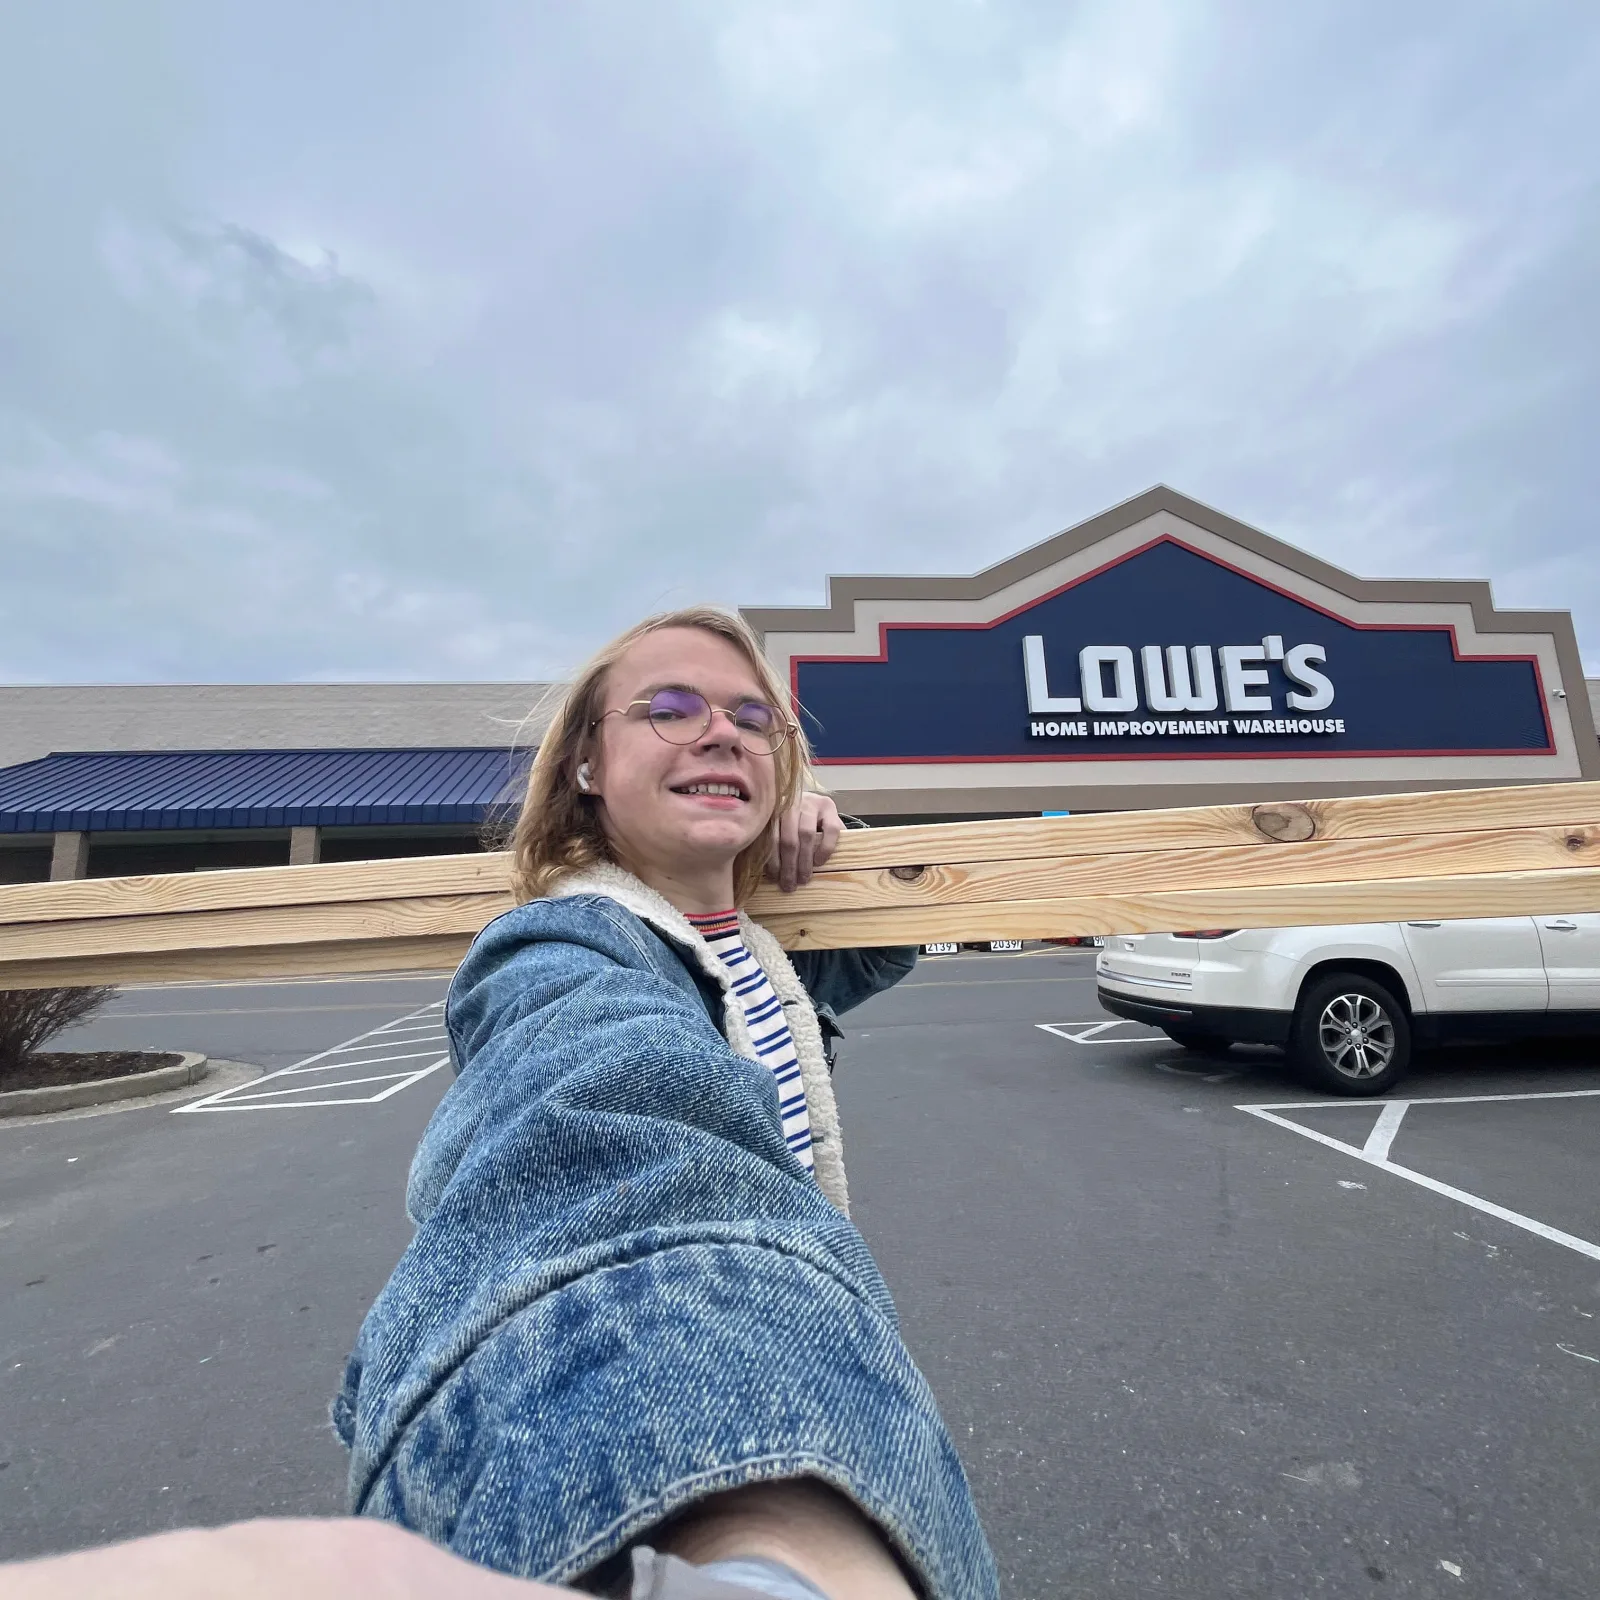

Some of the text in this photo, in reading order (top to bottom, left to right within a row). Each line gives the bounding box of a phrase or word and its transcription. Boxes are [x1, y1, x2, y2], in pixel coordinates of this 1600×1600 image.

[1022, 634, 1335, 714] LOWE'S
[1031, 719, 1346, 737] HOME IMPROVEMENT WAREHOUSE
